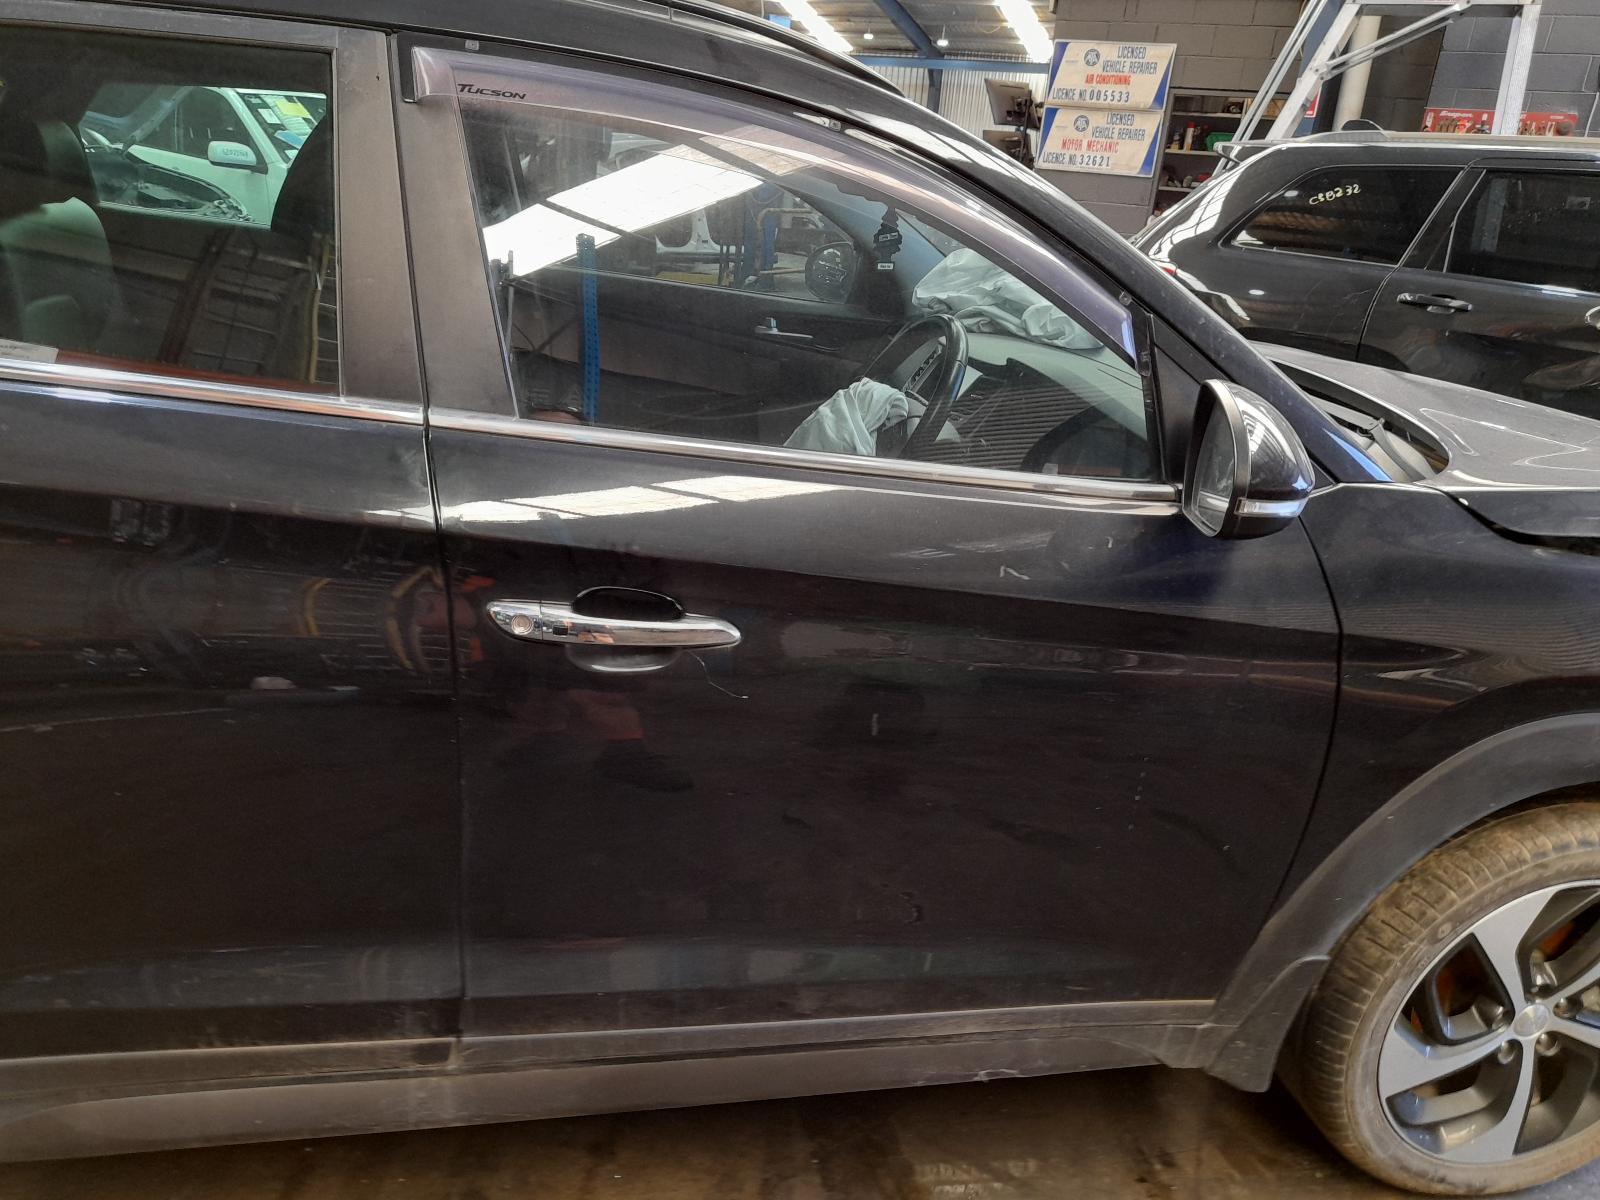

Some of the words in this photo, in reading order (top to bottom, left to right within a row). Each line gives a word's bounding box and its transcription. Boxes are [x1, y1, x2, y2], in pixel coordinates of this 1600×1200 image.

[1117, 46, 1147, 59] LICENSED
[1102, 60, 1126, 73] VEHICLE
[1129, 61, 1157, 75] REPAIRER
[1085, 74, 1095, 85] AIR
[1096, 74, 1131, 86] CONDITIONING
[457, 83, 527, 99] TUCSON
[1052, 87, 1076, 100] LICENCE
[1089, 89, 1130, 103] 005533
[1106, 112, 1135, 125] LICENSED
[1091, 126, 1115, 139] VEHICLE
[1117, 127, 1146, 141] REPAIRER
[1061, 138, 1083, 151] MOTOR
[1087, 139, 1119, 153] MECHANIC
[1042, 152, 1066, 165] LICENCE
[1079, 154, 1110, 167] 32621
